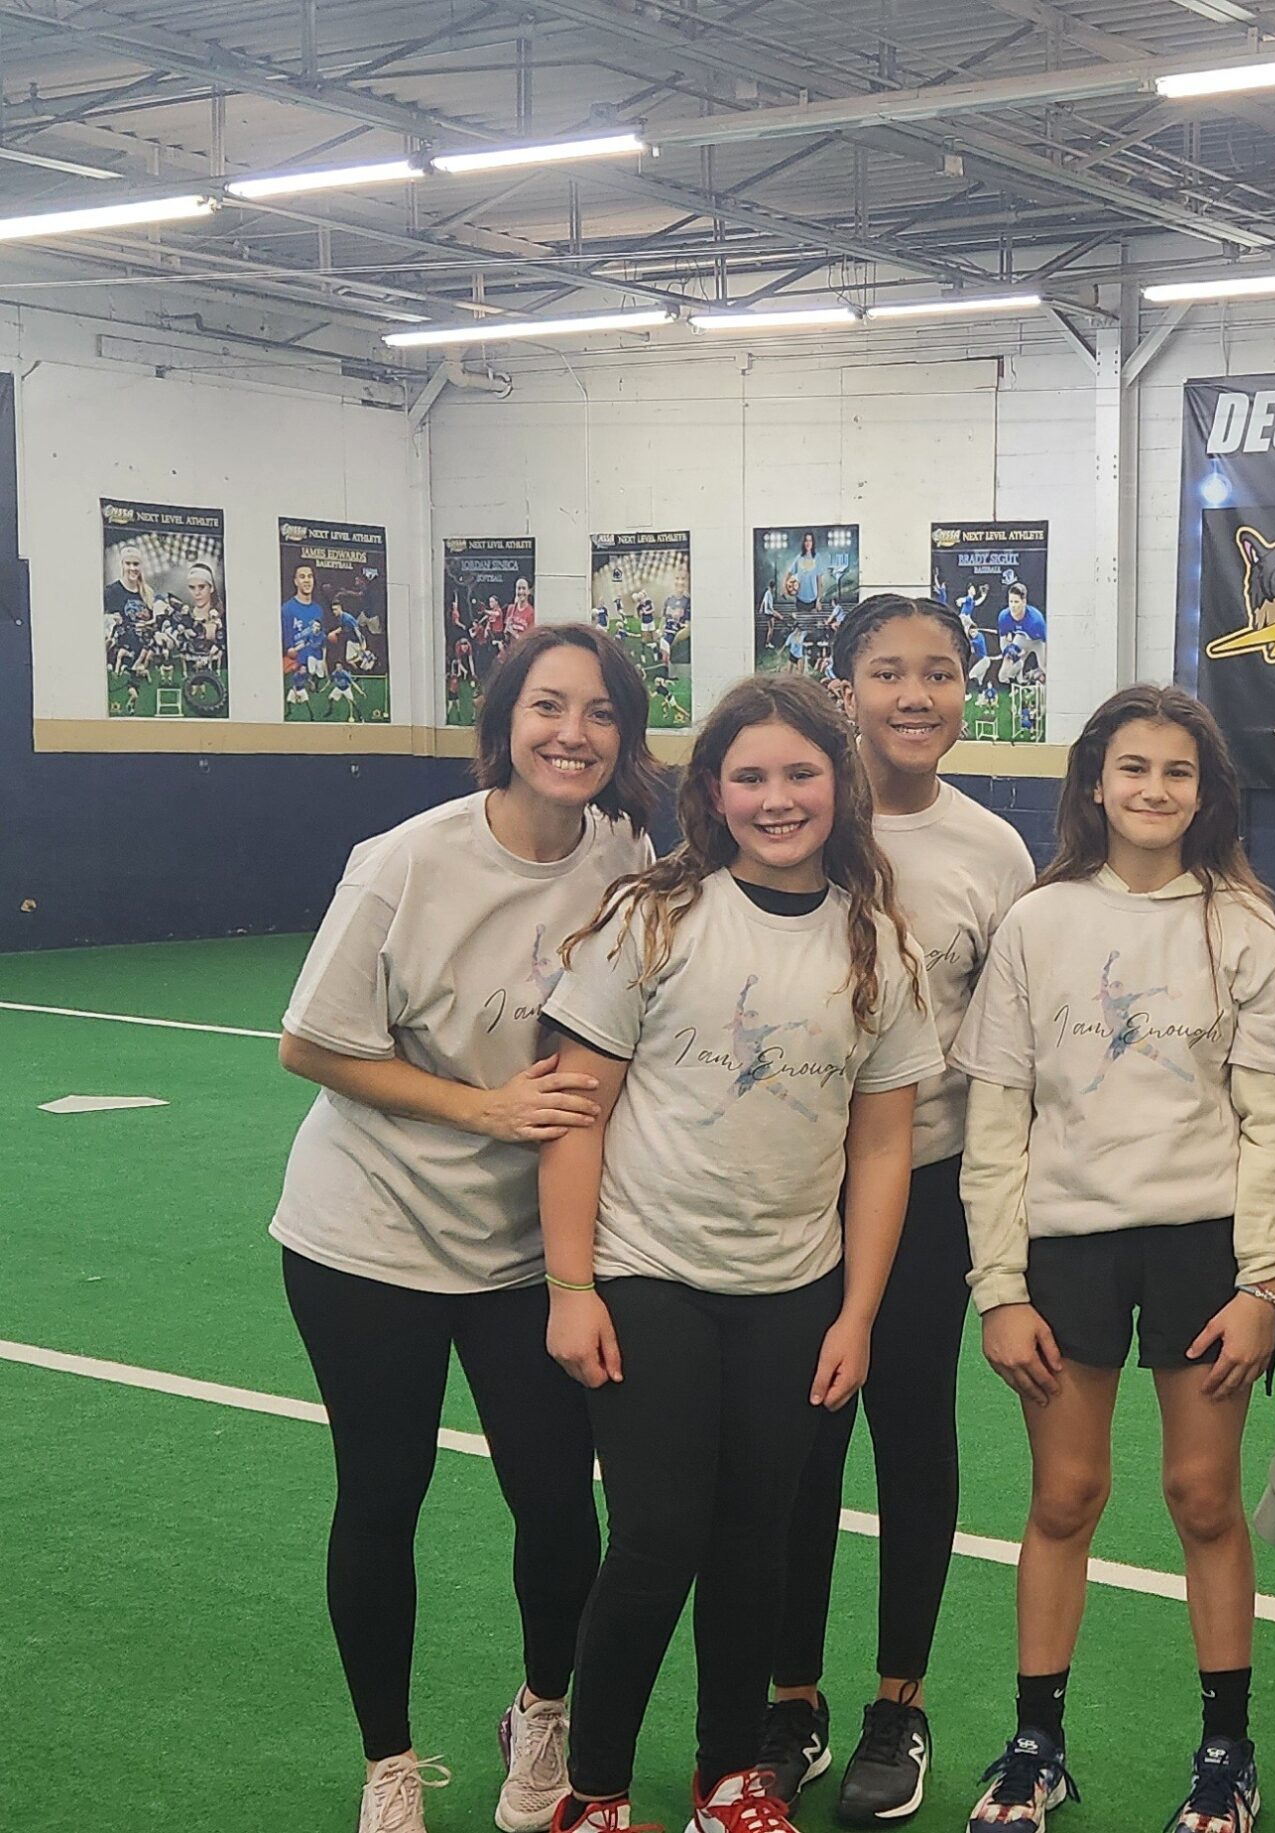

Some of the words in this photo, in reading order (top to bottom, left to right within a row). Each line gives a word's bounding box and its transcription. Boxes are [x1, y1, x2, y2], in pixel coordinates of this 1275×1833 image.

[136, 512, 159, 523] NEXT
[161, 514, 184, 525] LEVEL
[186, 516, 219, 527] ATHLETE
[308, 529, 329, 539] NEXT
[331, 531, 351, 541] LEVEL
[352, 533, 382, 544] ATHLETE
[962, 531, 985, 542] NEXT
[985, 531, 1007, 541] LEVEL
[1009, 530, 1045, 540] ATHLETE
[301, 547, 326, 559] JAMES
[327, 549, 367, 562] EDWARDS
[958, 553, 987, 566] BRADY
[484, 988, 507, 1033] I
[1053, 1004, 1069, 1048] I
[1073, 1021, 1113, 1038] am
[1123, 1011, 1225, 1049] Enough
[674, 1027, 697, 1064] I
[698, 1051, 741, 1072] am
